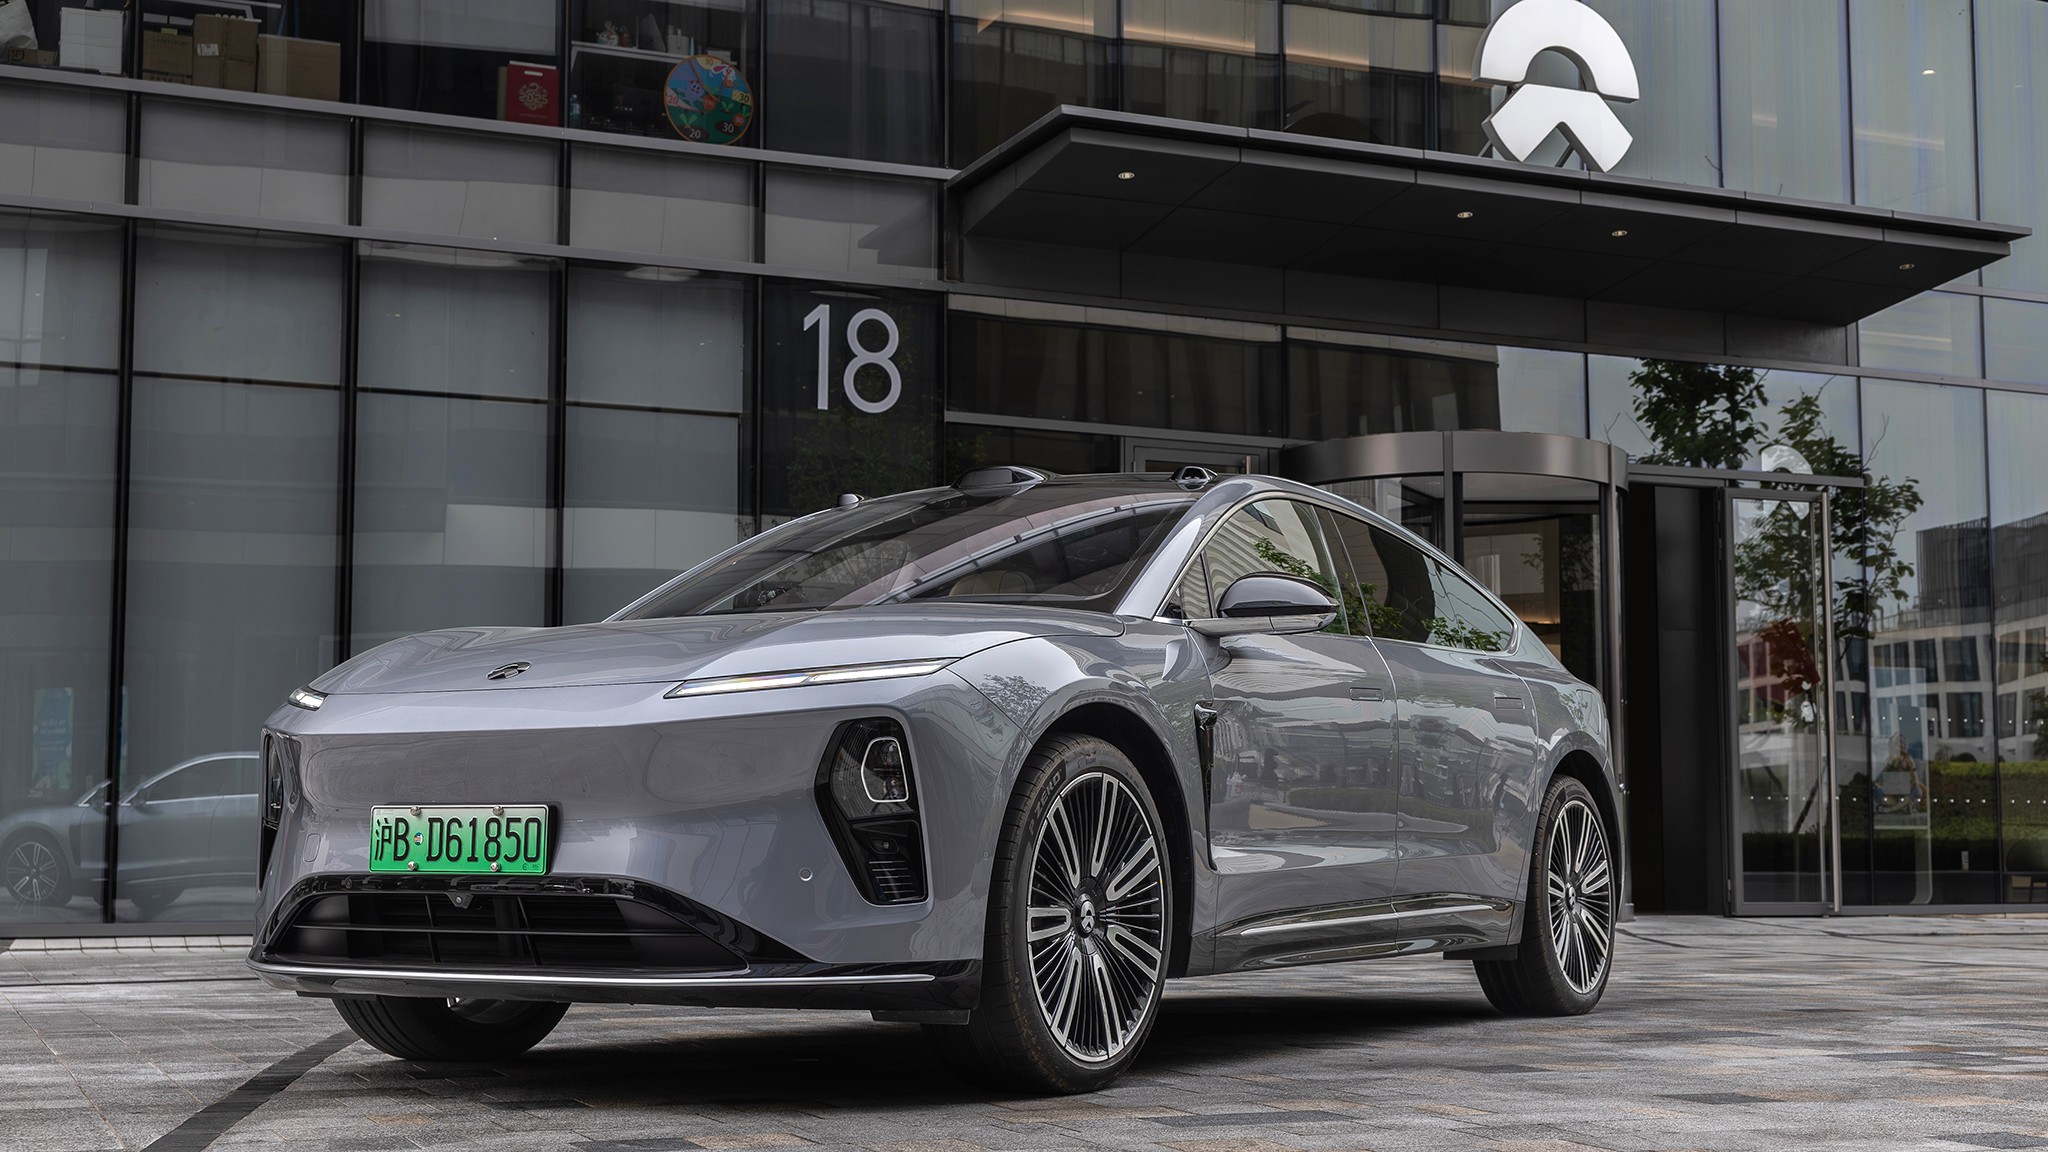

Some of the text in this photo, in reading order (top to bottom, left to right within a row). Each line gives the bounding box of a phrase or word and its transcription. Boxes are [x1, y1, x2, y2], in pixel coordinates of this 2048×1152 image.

[518, 91, 549, 105] 2025
[667, 95, 679, 105] 20
[739, 93, 750, 103] 30
[722, 122, 734, 133] 30
[689, 128, 702, 139] 20
[803, 303, 902, 414] 18
[426, 817, 542, 863] D61850
